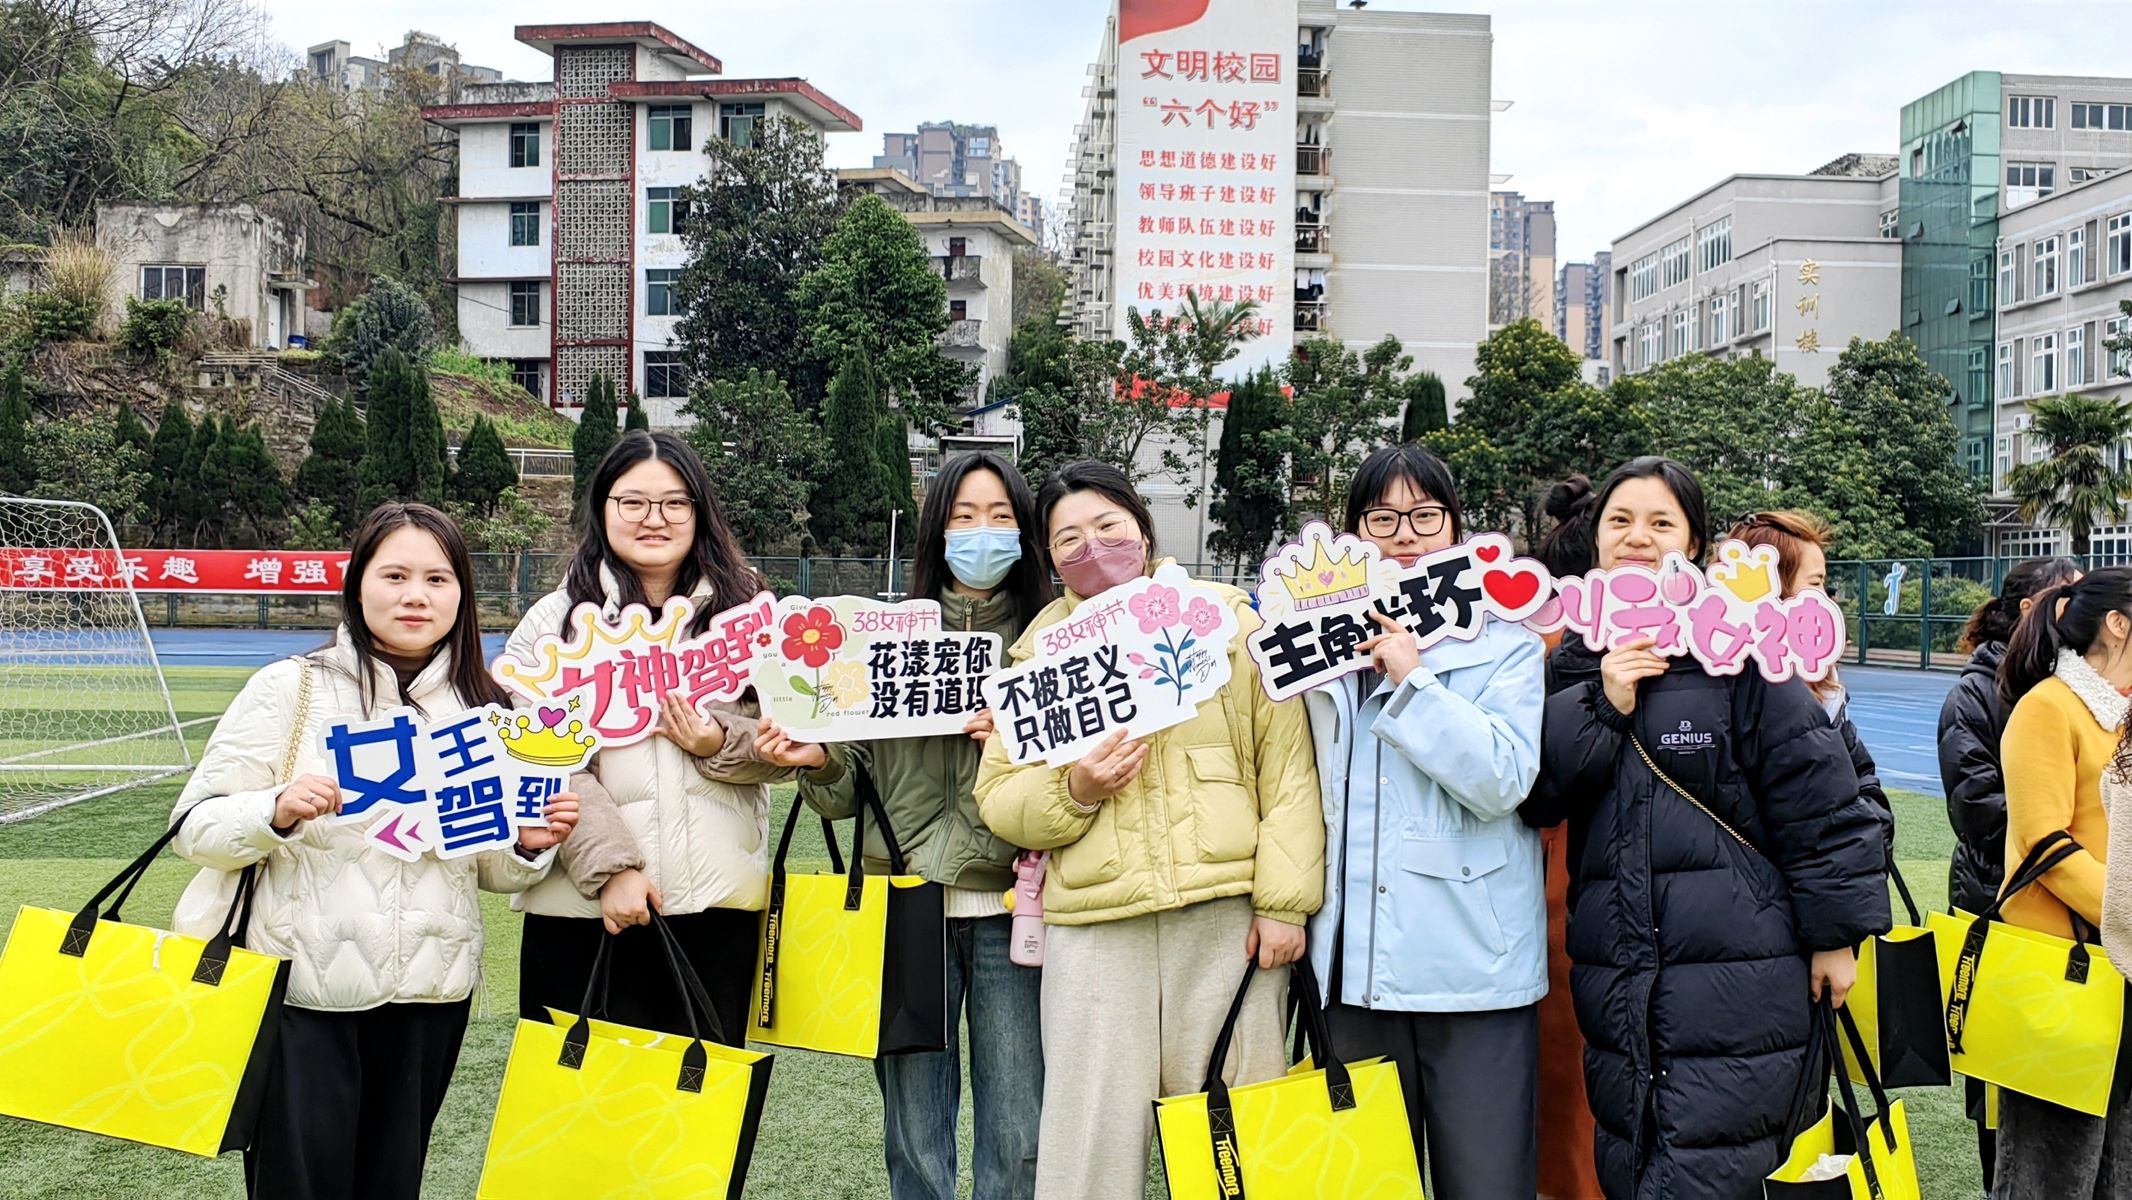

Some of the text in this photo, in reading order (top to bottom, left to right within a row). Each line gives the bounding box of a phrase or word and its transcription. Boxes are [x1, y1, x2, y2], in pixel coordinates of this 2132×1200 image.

[1140, 49, 1281, 83] 文明校园
[1139, 150, 1277, 171] 思想道德建设好
[1139, 182, 1276, 204] 领导班子建设好
[1138, 215, 1276, 237] 教师队伍建设好
[1137, 249, 1275, 270] 校园文化建设好
[1137, 281, 1275, 303] 优美环境建设好
[1795, 258, 1821, 354] 实训楼
[14, 556, 350, 585] 享受乐趣 增强
[852, 608, 938, 643] 38女神节
[1043, 599, 1126, 656] 38女神节
[763, 651, 778, 659] you
[867, 636, 993, 680] 花漾宠你
[998, 644, 1129, 718] 不被定义
[826, 708, 870, 718] red flower
[1013, 683, 1138, 760] 只做自己
[1660, 732, 1712, 745] GENIUS
